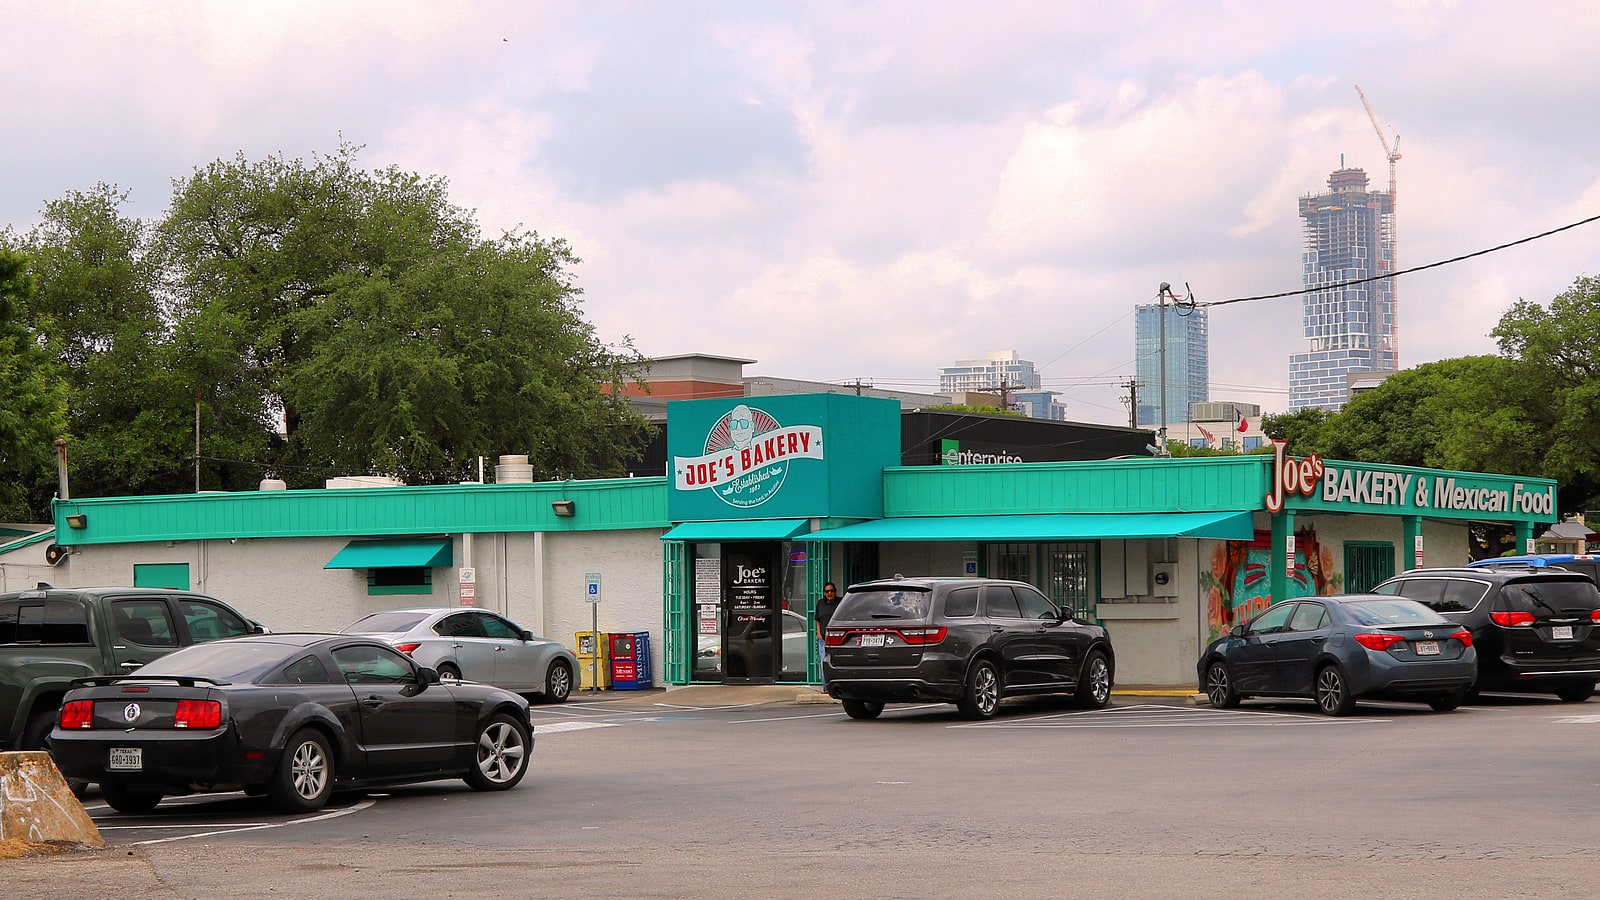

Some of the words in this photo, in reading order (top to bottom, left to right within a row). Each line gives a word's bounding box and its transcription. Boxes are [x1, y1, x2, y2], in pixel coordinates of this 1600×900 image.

[686, 455, 735, 485] JOE'S
[741, 432, 810, 471] BAKERY
[1266, 439, 1325, 513] Joe's
[1323, 467, 1412, 505] BAKERY
[1415, 477, 1429, 507] &
[1434, 477, 1509, 512] Mexican
[1512, 482, 1553, 514] Food
[732, 467, 770, 493] Established
[733, 565, 766, 584] Joe's
